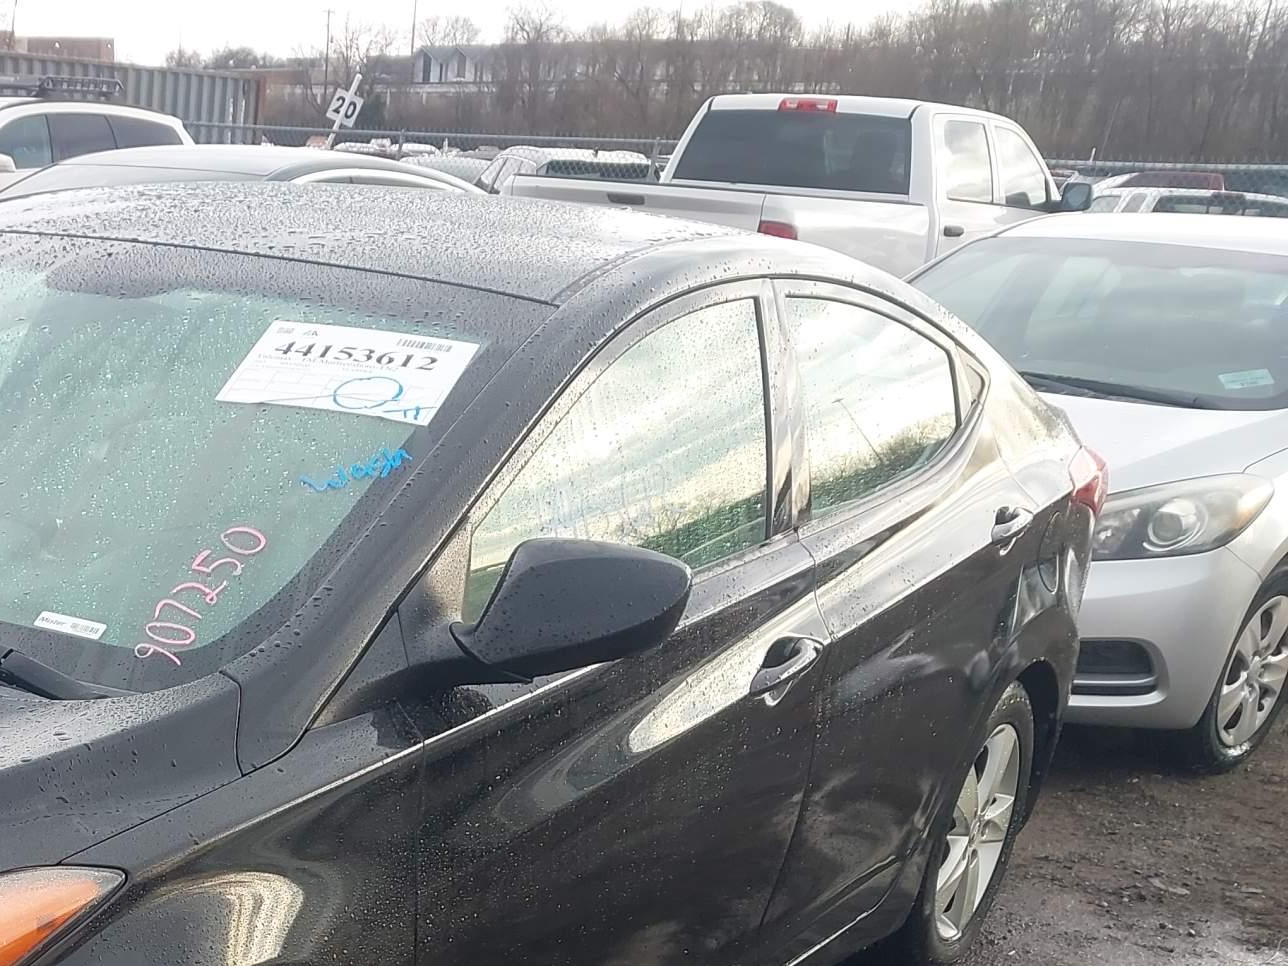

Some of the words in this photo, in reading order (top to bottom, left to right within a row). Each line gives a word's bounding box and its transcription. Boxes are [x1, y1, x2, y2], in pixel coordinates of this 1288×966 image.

[332, 95, 357, 119] 20
[274, 341, 438, 371] 44153612
[134, 526, 267, 666] 907250
